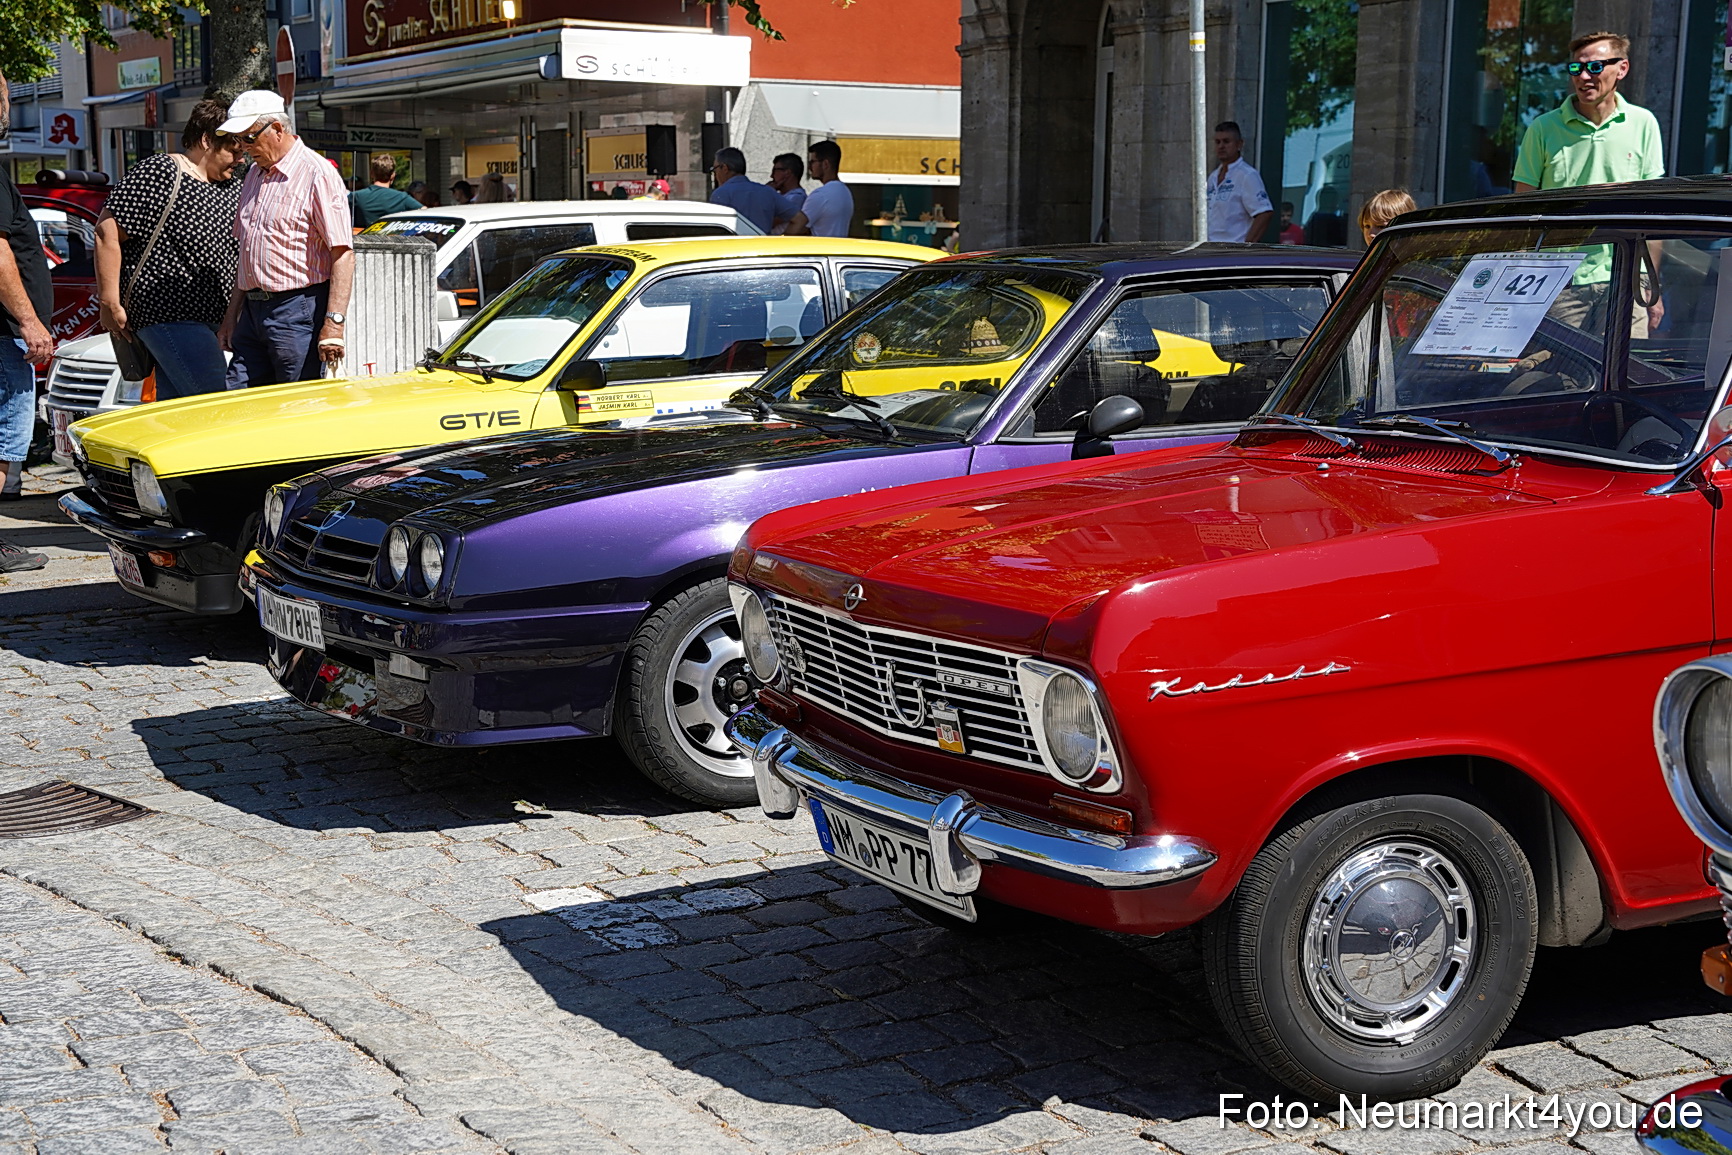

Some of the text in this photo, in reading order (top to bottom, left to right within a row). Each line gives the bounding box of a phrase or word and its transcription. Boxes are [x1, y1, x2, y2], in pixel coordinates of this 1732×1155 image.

[350, 130, 375, 142] NZ
[379, 220, 456, 236] Motorsport
[1504, 274, 1549, 296] 421
[439, 409, 522, 431] GT/E
[944, 674, 1005, 693] OPEL
[1148, 661, 1351, 702] Kadett
[1314, 795, 1398, 849] FALKEN
[825, 808, 860, 861] NM
[863, 827, 899, 877] PP
[899, 841, 935, 892] 77
